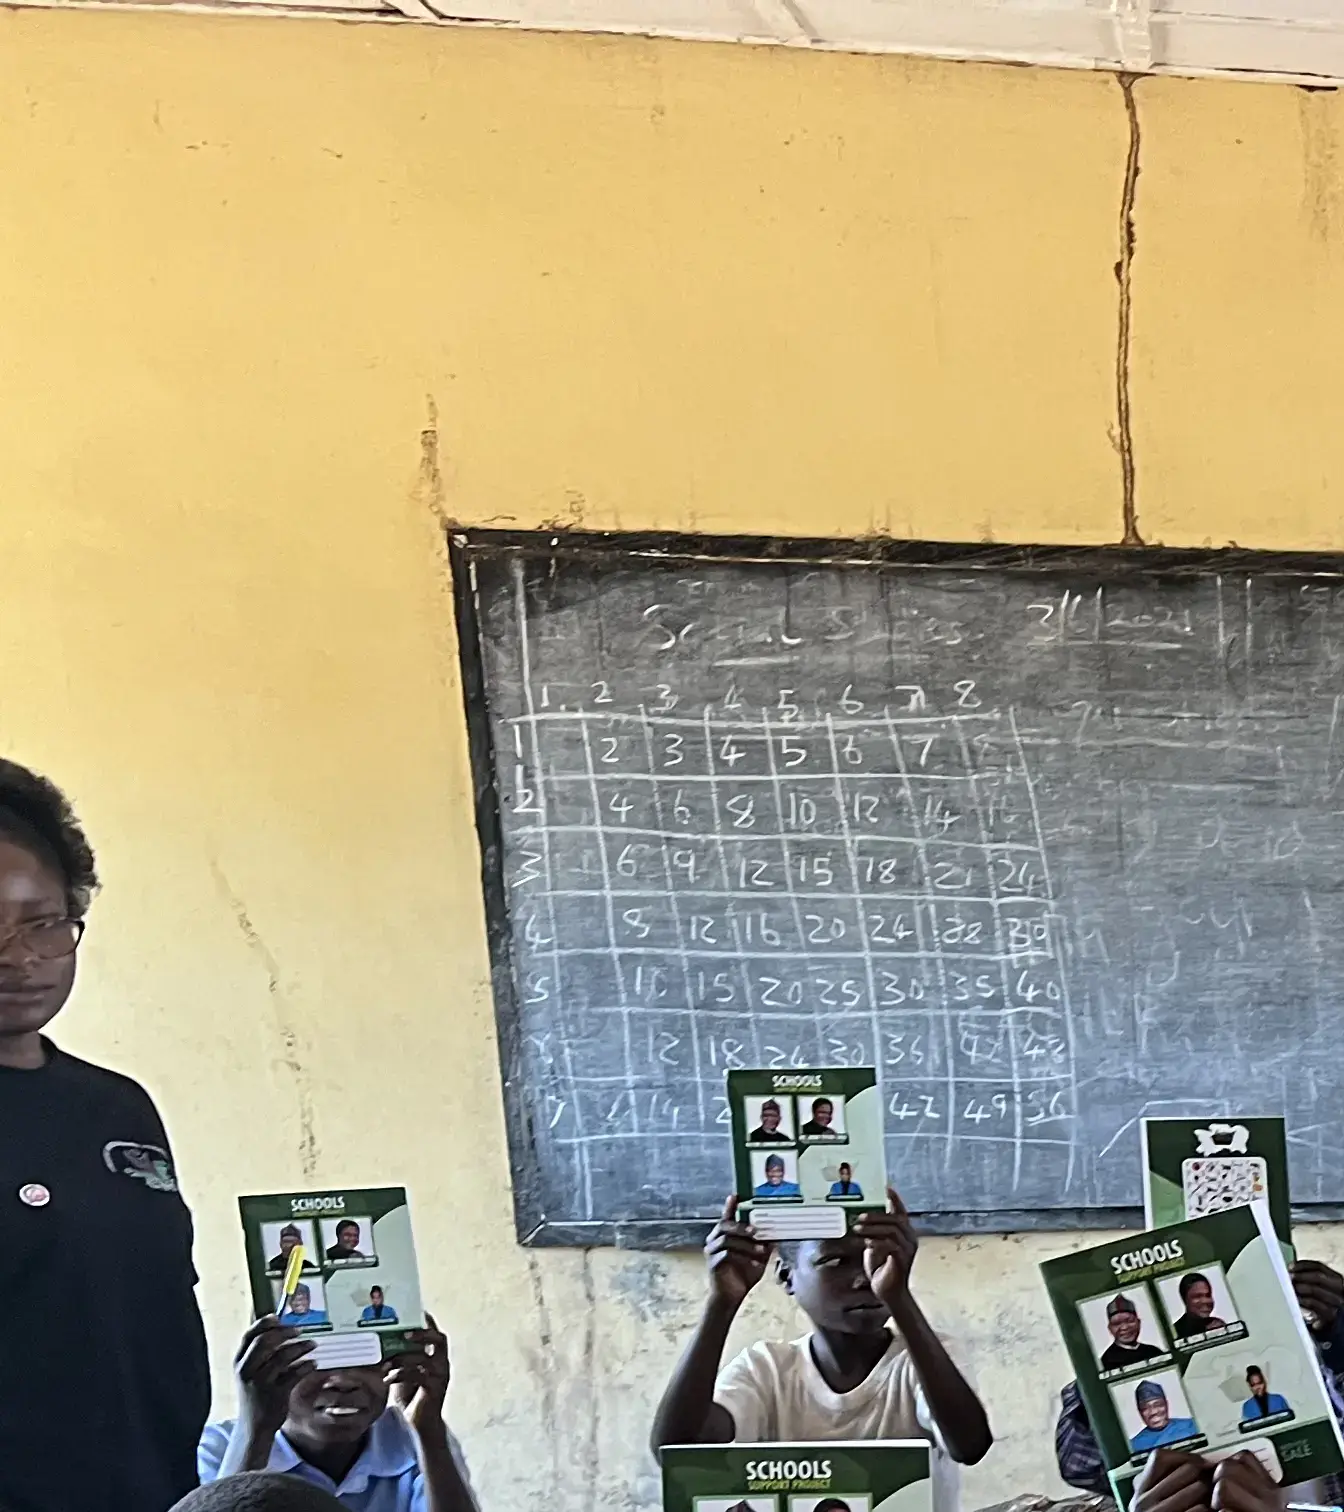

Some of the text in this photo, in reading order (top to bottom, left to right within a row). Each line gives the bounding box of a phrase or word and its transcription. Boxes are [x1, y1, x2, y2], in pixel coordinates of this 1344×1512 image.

[591, 681, 613, 703] 2
[654, 684, 679, 711] 3
[778, 690, 799, 719] 5
[839, 684, 864, 714] 6
[953, 680, 982, 708] 8
[600, 737, 620, 763] 2
[663, 734, 684, 766] 3
[720, 735, 746, 767] 4
[781, 735, 807, 767] 5
[842, 735, 862, 765] 6
[909, 736, 935, 767] 7
[512, 788, 544, 813] 2
[609, 793, 634, 823] 4
[674, 789, 692, 825] 6
[725, 794, 756, 828] 8
[787, 792, 816, 828] 10
[853, 791, 880, 823] 12
[511, 844, 1036, 897] 3 6 9 12 15 18 21 24
[524, 913, 554, 950] 4
[622, 907, 651, 939] 8
[690, 915, 717, 944] 12
[746, 912, 781, 946] 16
[805, 914, 846, 944] 20
[868, 914, 914, 944] 24
[699, 971, 735, 1003] 15
[759, 976, 802, 1007] 20
[816, 978, 861, 1007] 25
[880, 971, 925, 1006] 30
[950, 970, 995, 1001] 35
[1017, 970, 1061, 1003] 40
[709, 1034, 746, 1069] 18
[764, 1045, 810, 1069] 24
[828, 1037, 865, 1067] 30
[889, 1091, 941, 1120] 42
[963, 1092, 1006, 1125] 49
[291, 1195, 345, 1212] SCHOOLS
[1110, 1238, 1184, 1275] SCHOOLS
[745, 1460, 832, 1480] SCHOOLS
